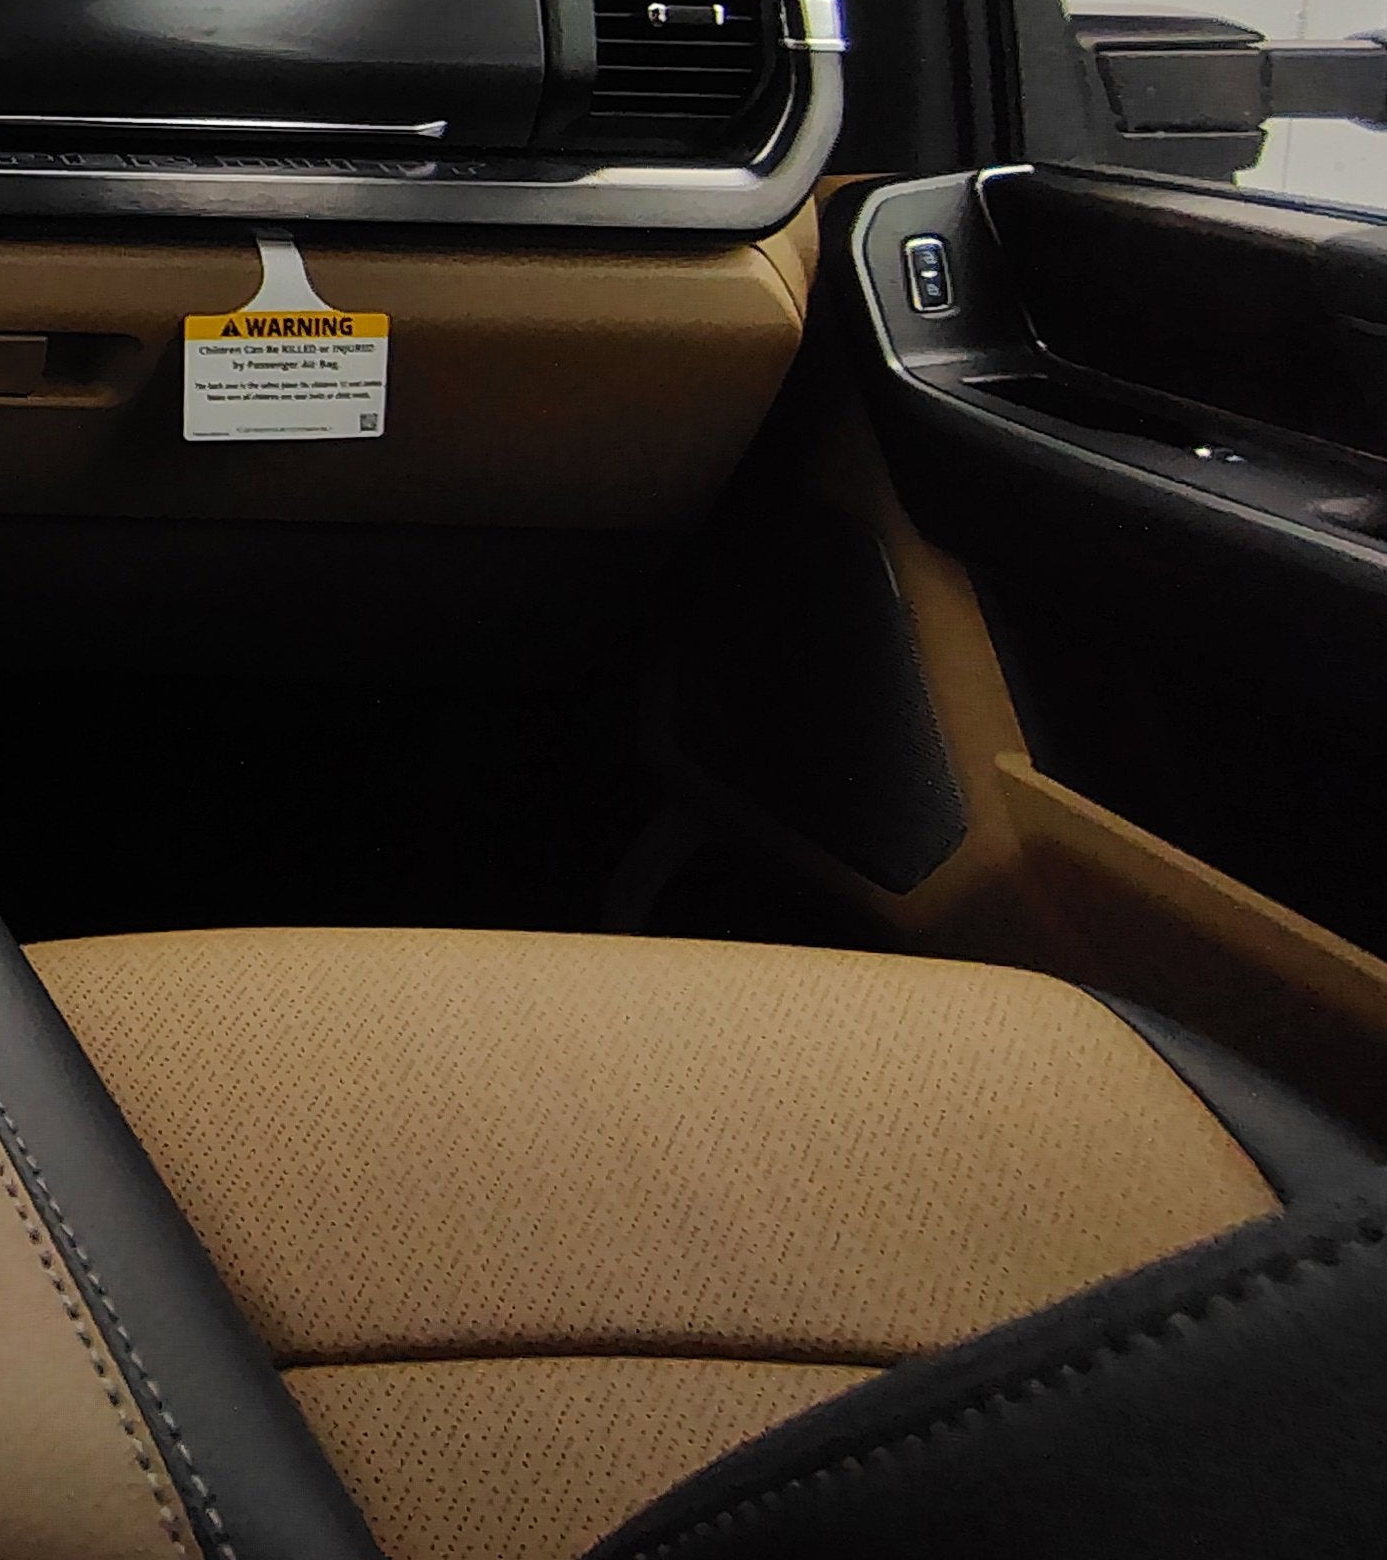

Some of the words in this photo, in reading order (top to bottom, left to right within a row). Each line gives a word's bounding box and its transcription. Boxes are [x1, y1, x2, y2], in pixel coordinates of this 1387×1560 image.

[245, 317, 354, 337] WARNING
[198, 344, 242, 355] Children
[244, 345, 263, 354] Can
[266, 344, 280, 354] Be
[282, 344, 317, 354] KILLED
[232, 360, 244, 371] by
